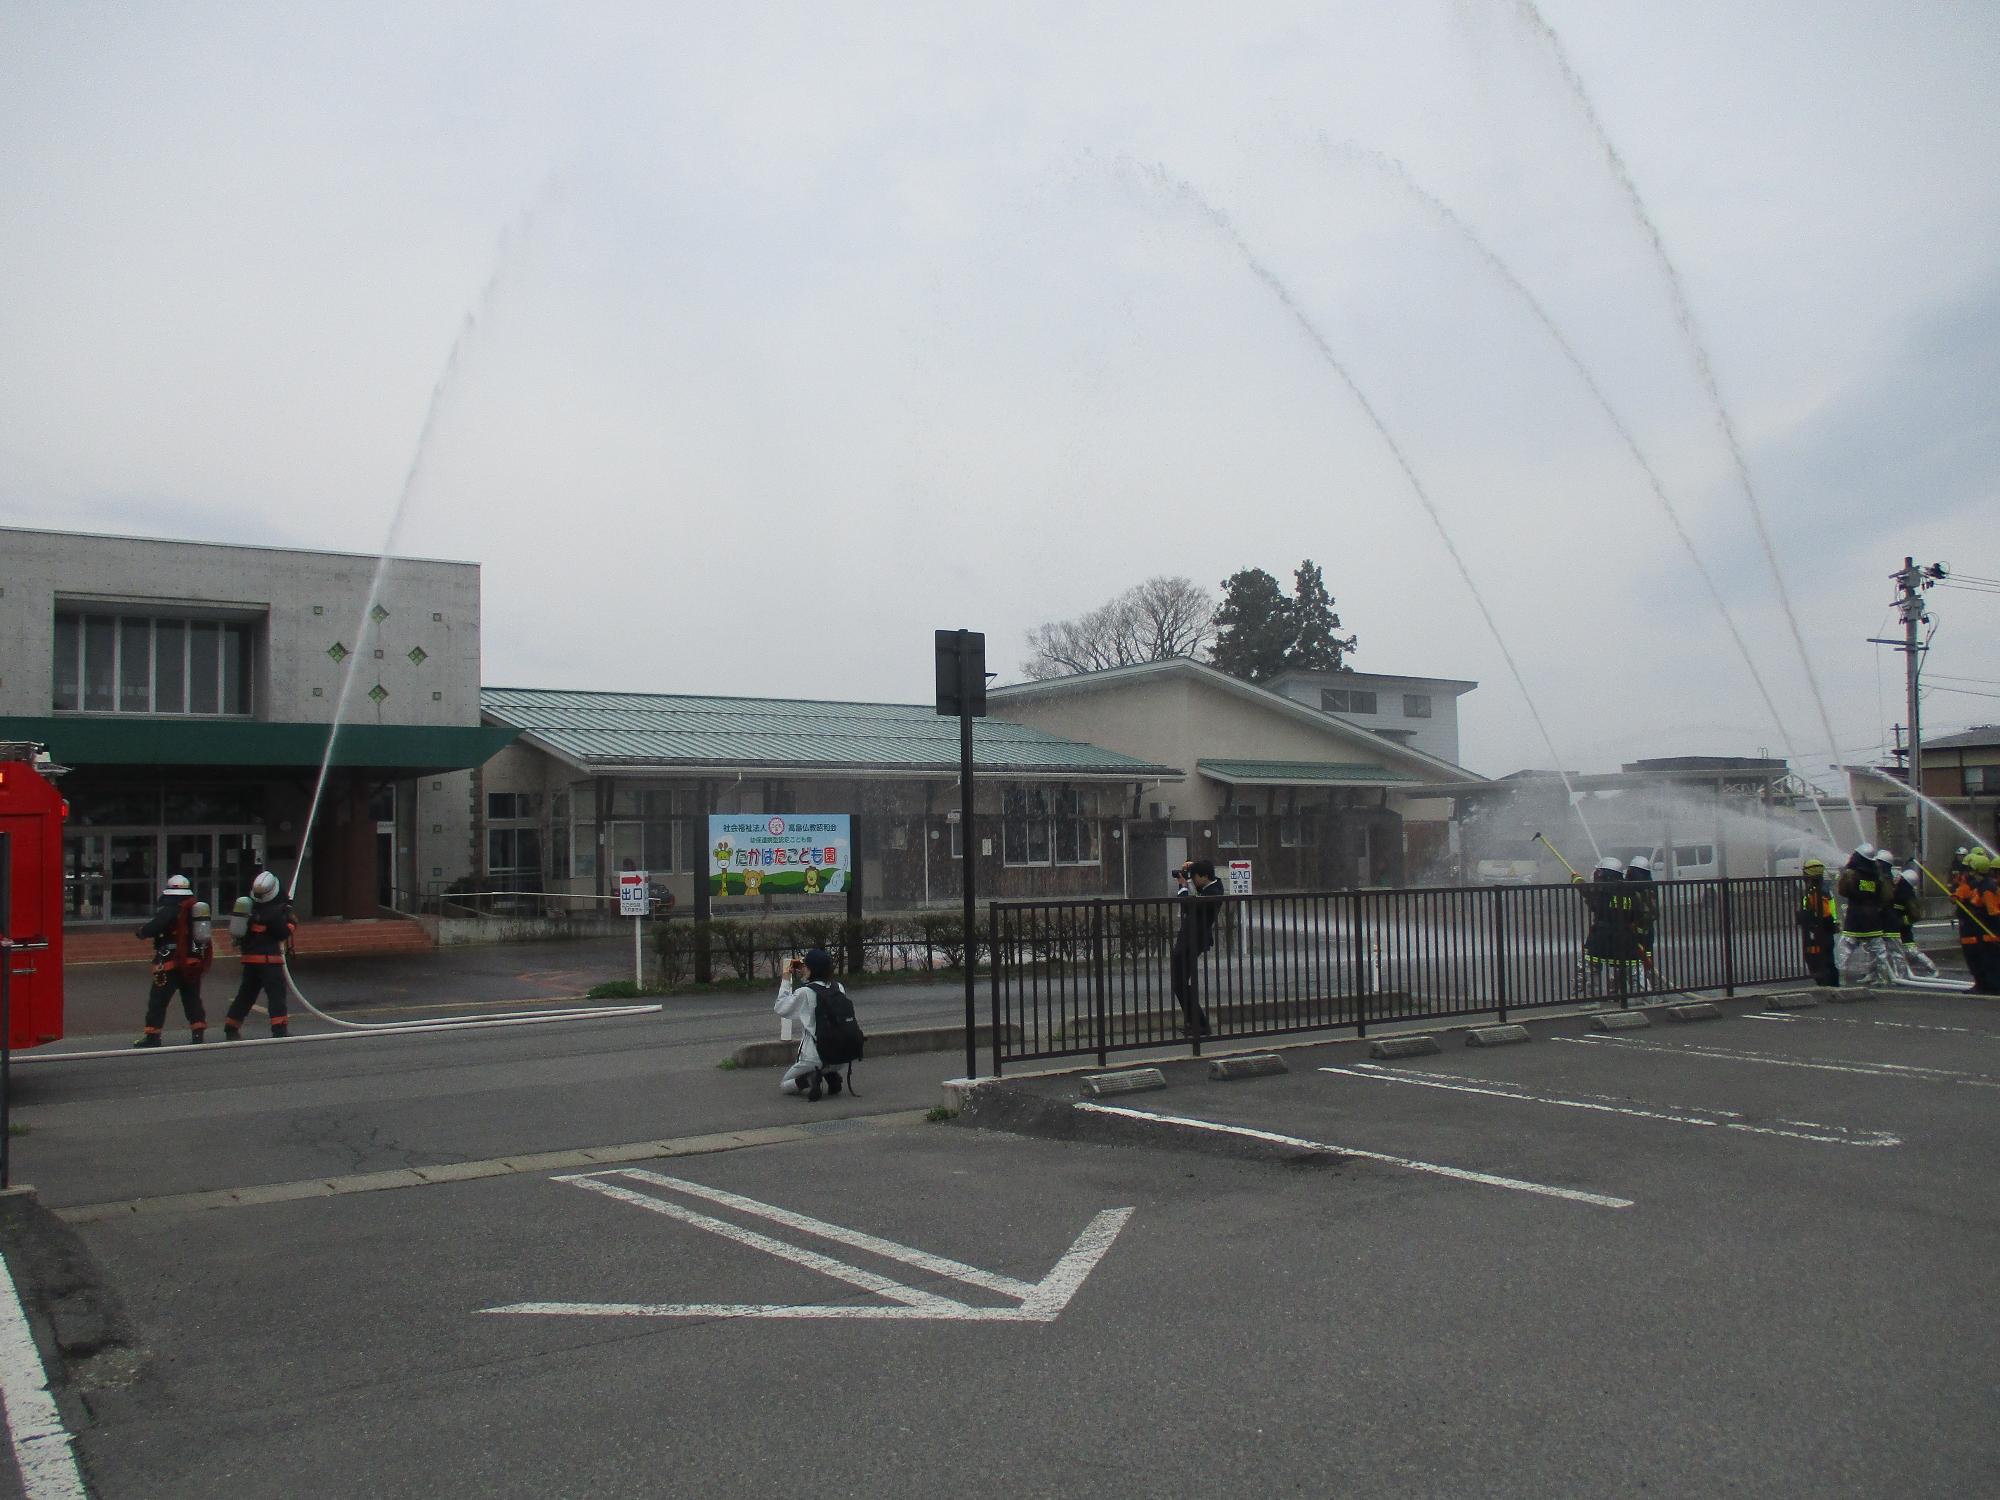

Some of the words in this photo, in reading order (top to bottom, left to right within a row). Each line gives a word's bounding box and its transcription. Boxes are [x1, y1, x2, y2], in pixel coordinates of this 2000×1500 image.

[723, 824, 767, 832] 社会福祉法人
[735, 847, 837, 866] たかはたこども園
[1231, 871, 1250, 879] 出入口
[622, 888, 642, 900] 出口
